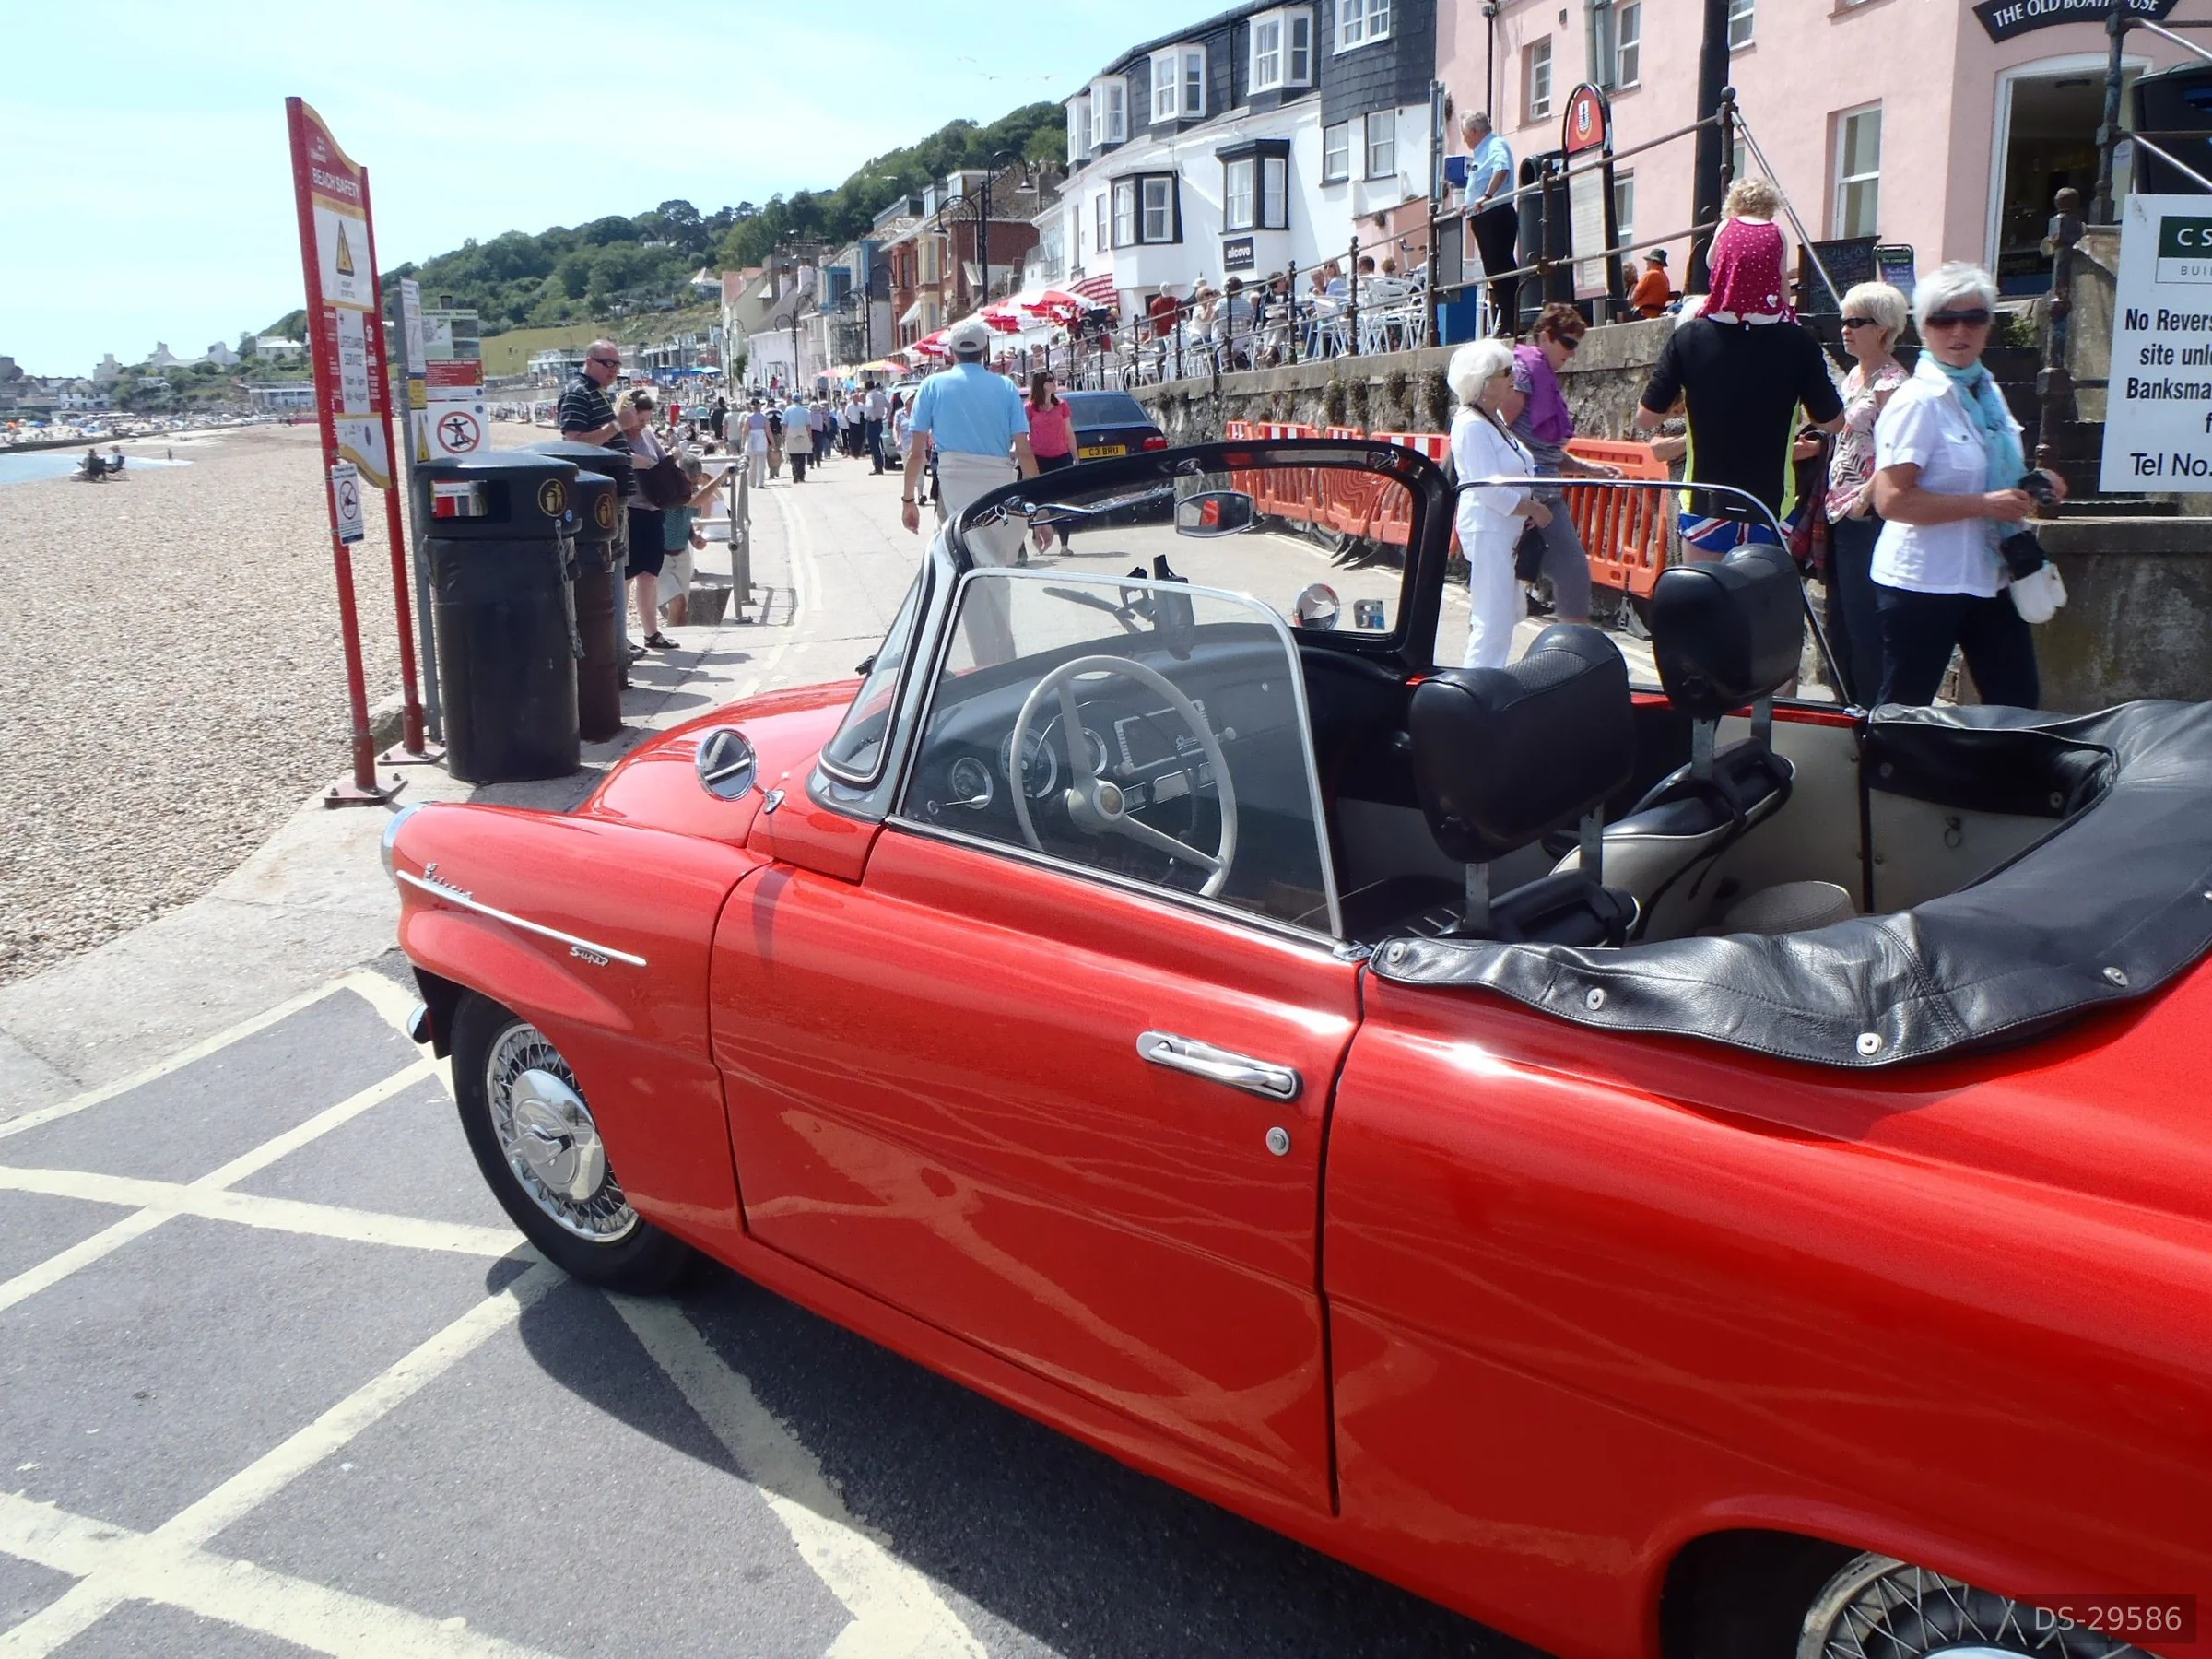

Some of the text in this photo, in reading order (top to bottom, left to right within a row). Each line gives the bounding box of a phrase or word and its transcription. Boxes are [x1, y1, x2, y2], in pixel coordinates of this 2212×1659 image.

[1993, 3, 2024, 27] THE
[2027, 0, 2061, 16] OLD
[312, 167, 359, 199] BEACH SAFETY
[1228, 246, 1251, 259] alcove
[2124, 308, 2149, 330] No
[2139, 343, 2174, 365] site
[2126, 377, 2212, 399] Banksma
[1088, 446, 1119, 456] C3 BRU
[2130, 453, 2163, 476] Tel
